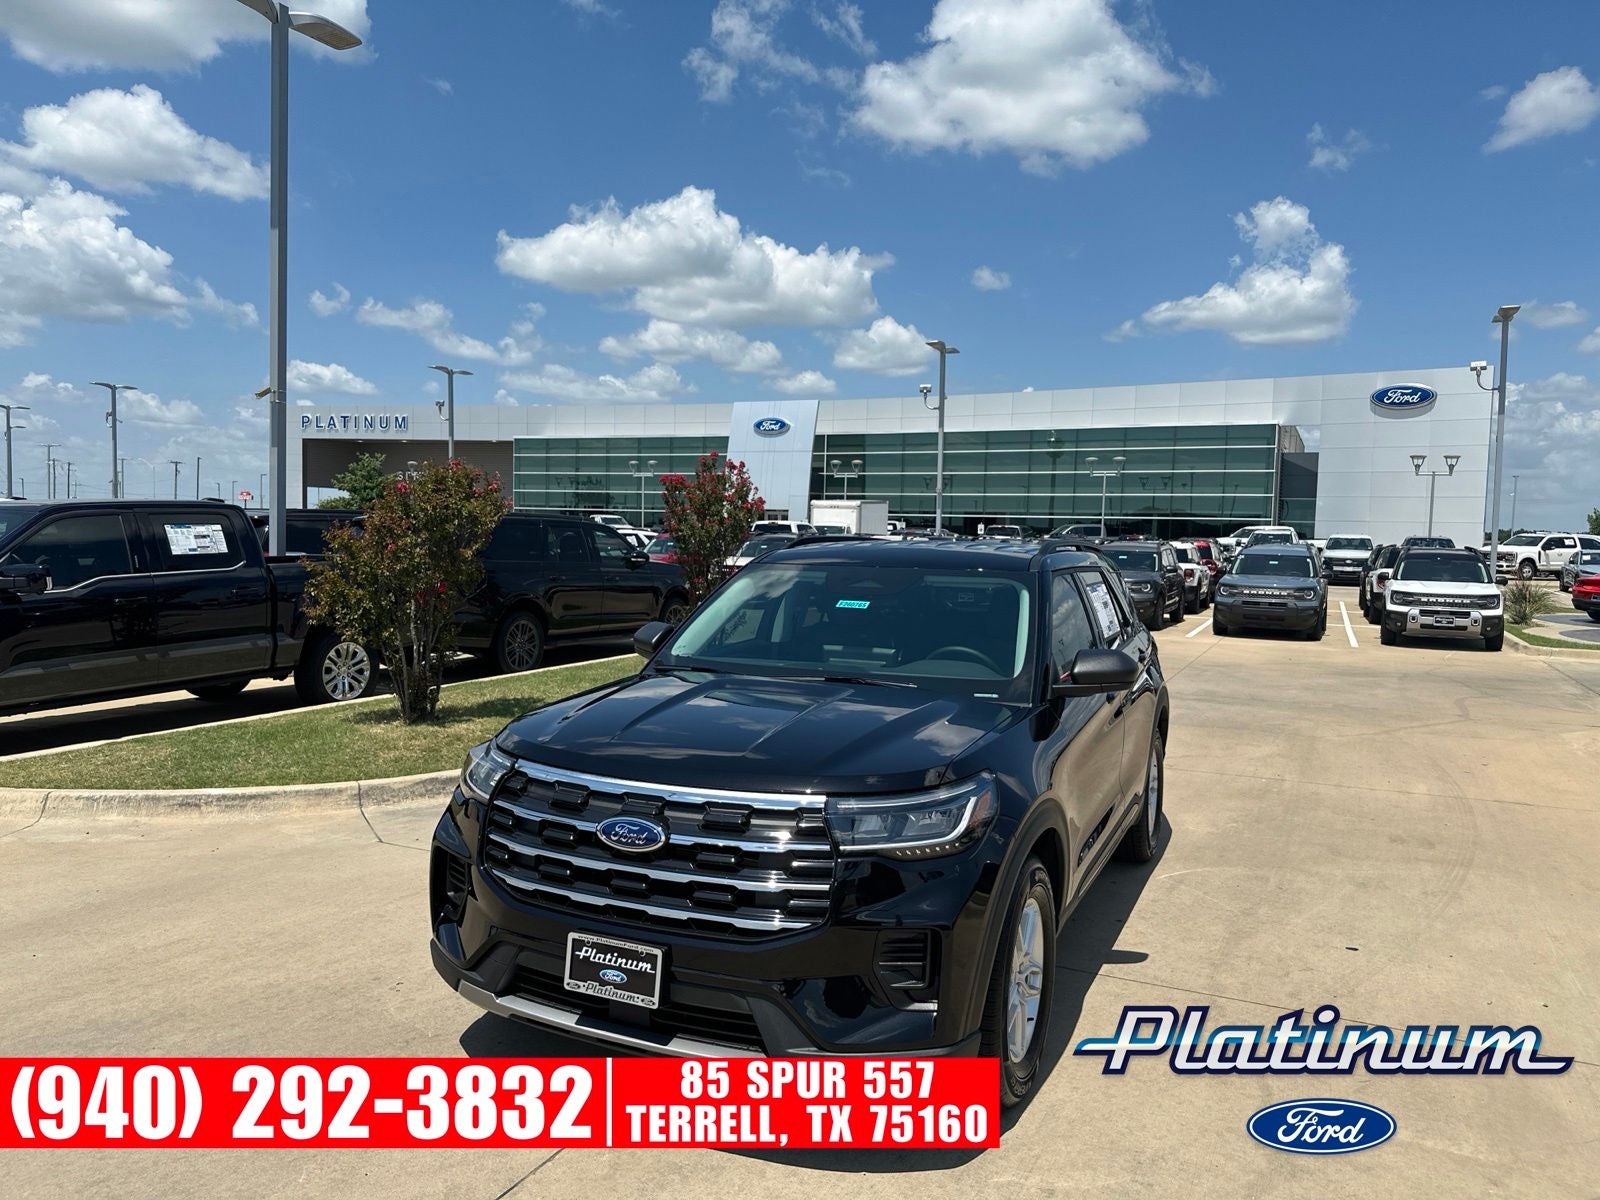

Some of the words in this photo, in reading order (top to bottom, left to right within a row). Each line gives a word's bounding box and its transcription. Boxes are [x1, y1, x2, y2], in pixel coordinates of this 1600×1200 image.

[1383, 389, 1422, 404] Ford
[300, 414, 409, 430] PLATINUM
[610, 823, 648, 845] Ford
[575, 946, 656, 974] Platinum
[585, 982, 640, 1003] Platinum
